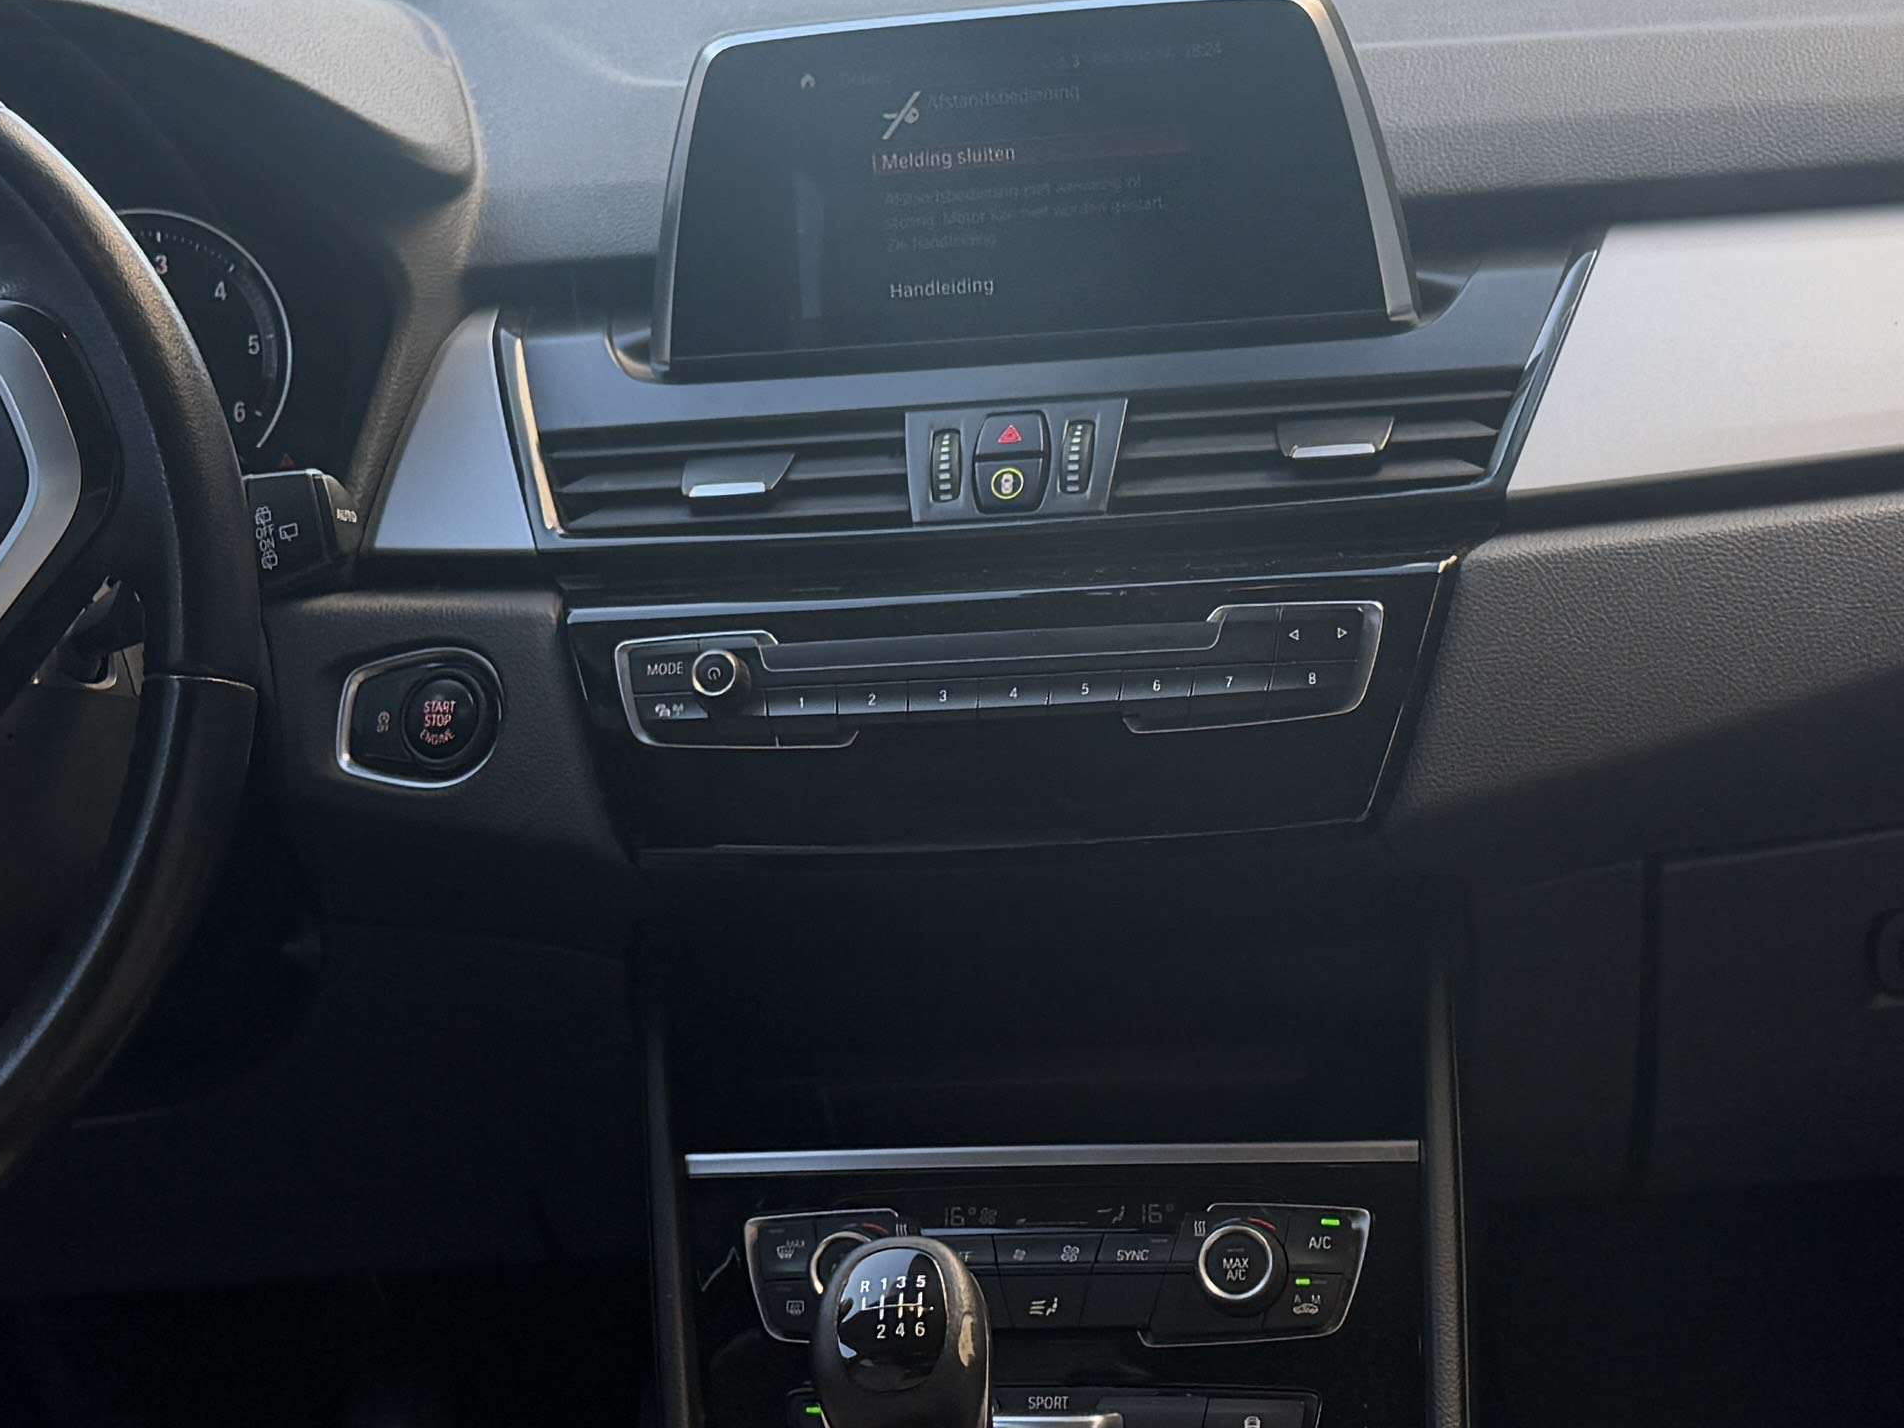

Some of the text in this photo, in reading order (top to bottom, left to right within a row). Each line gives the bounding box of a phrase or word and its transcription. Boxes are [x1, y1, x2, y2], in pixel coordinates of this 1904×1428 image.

[881, 145, 1017, 172] Melding sluiten
[155, 254, 169, 275] 3
[214, 280, 228, 301] 4
[889, 275, 995, 299] Handleiding
[247, 334, 260, 355] 5
[233, 401, 246, 422] 6
[646, 660, 685, 677] MODE
[867, 693, 877, 708] 2
[938, 689, 948, 704] 3
[1009, 686, 1019, 700] 4
[1081, 682, 1091, 697] 5
[1152, 678, 1162, 693] 6
[1225, 675, 1236, 689] 7
[1309, 671, 1319, 686] 8
[423, 700, 457, 714] START
[424, 714, 453, 727] STOP
[1307, 1234, 1333, 1251] A/C
[1115, 1248, 1151, 1262] SYNC
[1222, 1256, 1250, 1269] MAX
[859, 1274, 926, 1293] R 1 3 5
[1225, 1268, 1248, 1282] A/C
[876, 1321, 926, 1340] 2 4 6
[1027, 1395, 1070, 1411] SPORT
